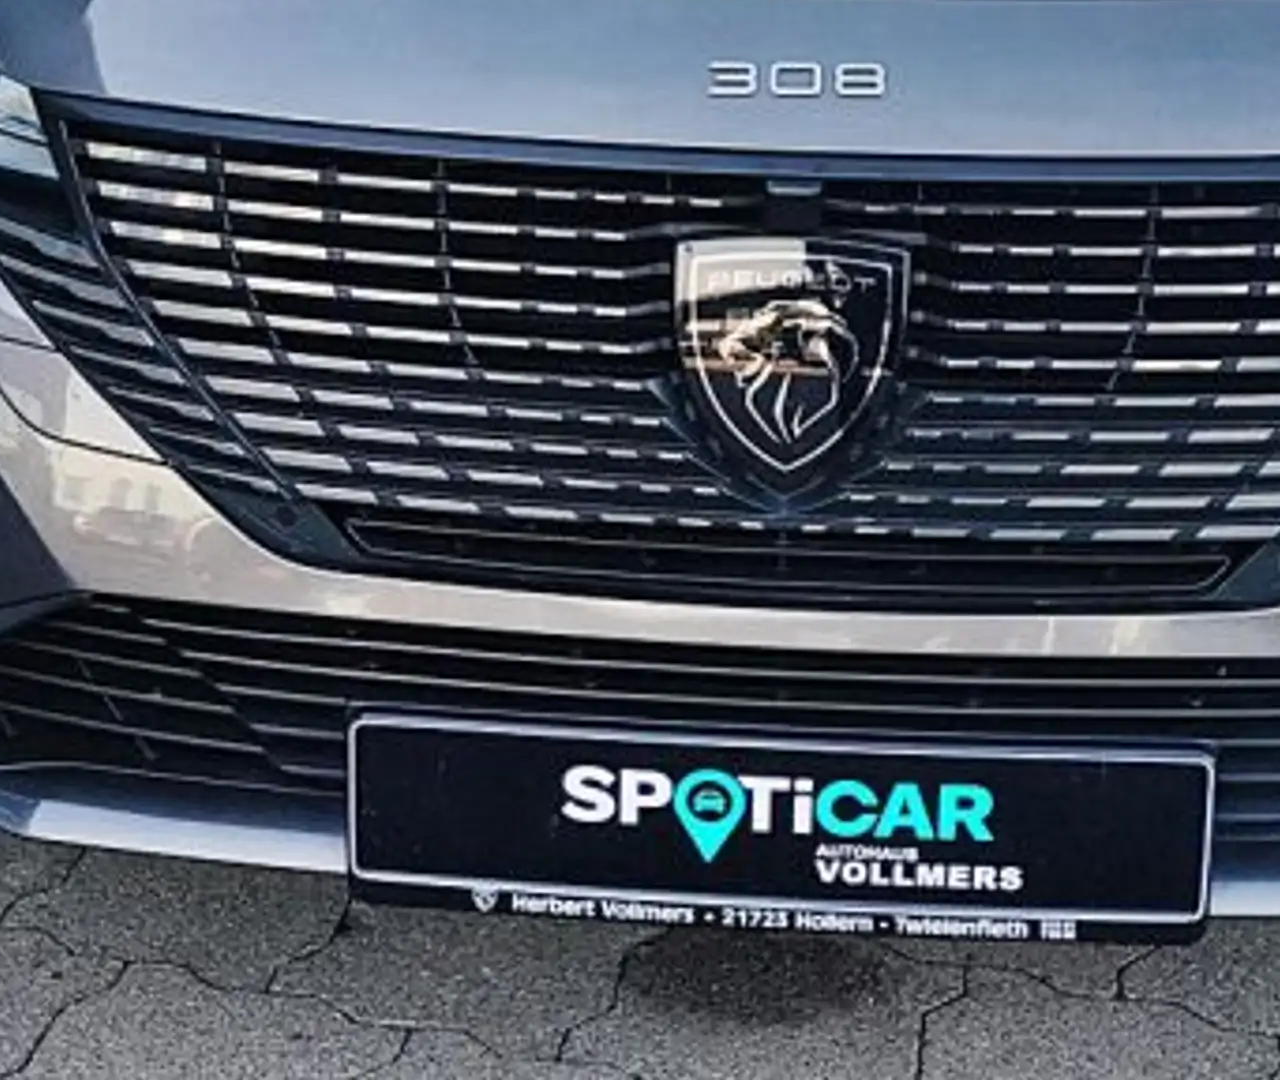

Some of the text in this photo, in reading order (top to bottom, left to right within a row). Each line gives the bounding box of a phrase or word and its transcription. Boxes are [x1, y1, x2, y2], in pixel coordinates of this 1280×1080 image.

[707, 60, 887, 97] 308
[815, 844, 919, 862] AUTOHAUS
[815, 858, 1024, 891] VOLLMERS
[512, 893, 596, 917] Herbert
[601, 900, 695, 923] Vollmers
[721, 905, 788, 928] 21723
